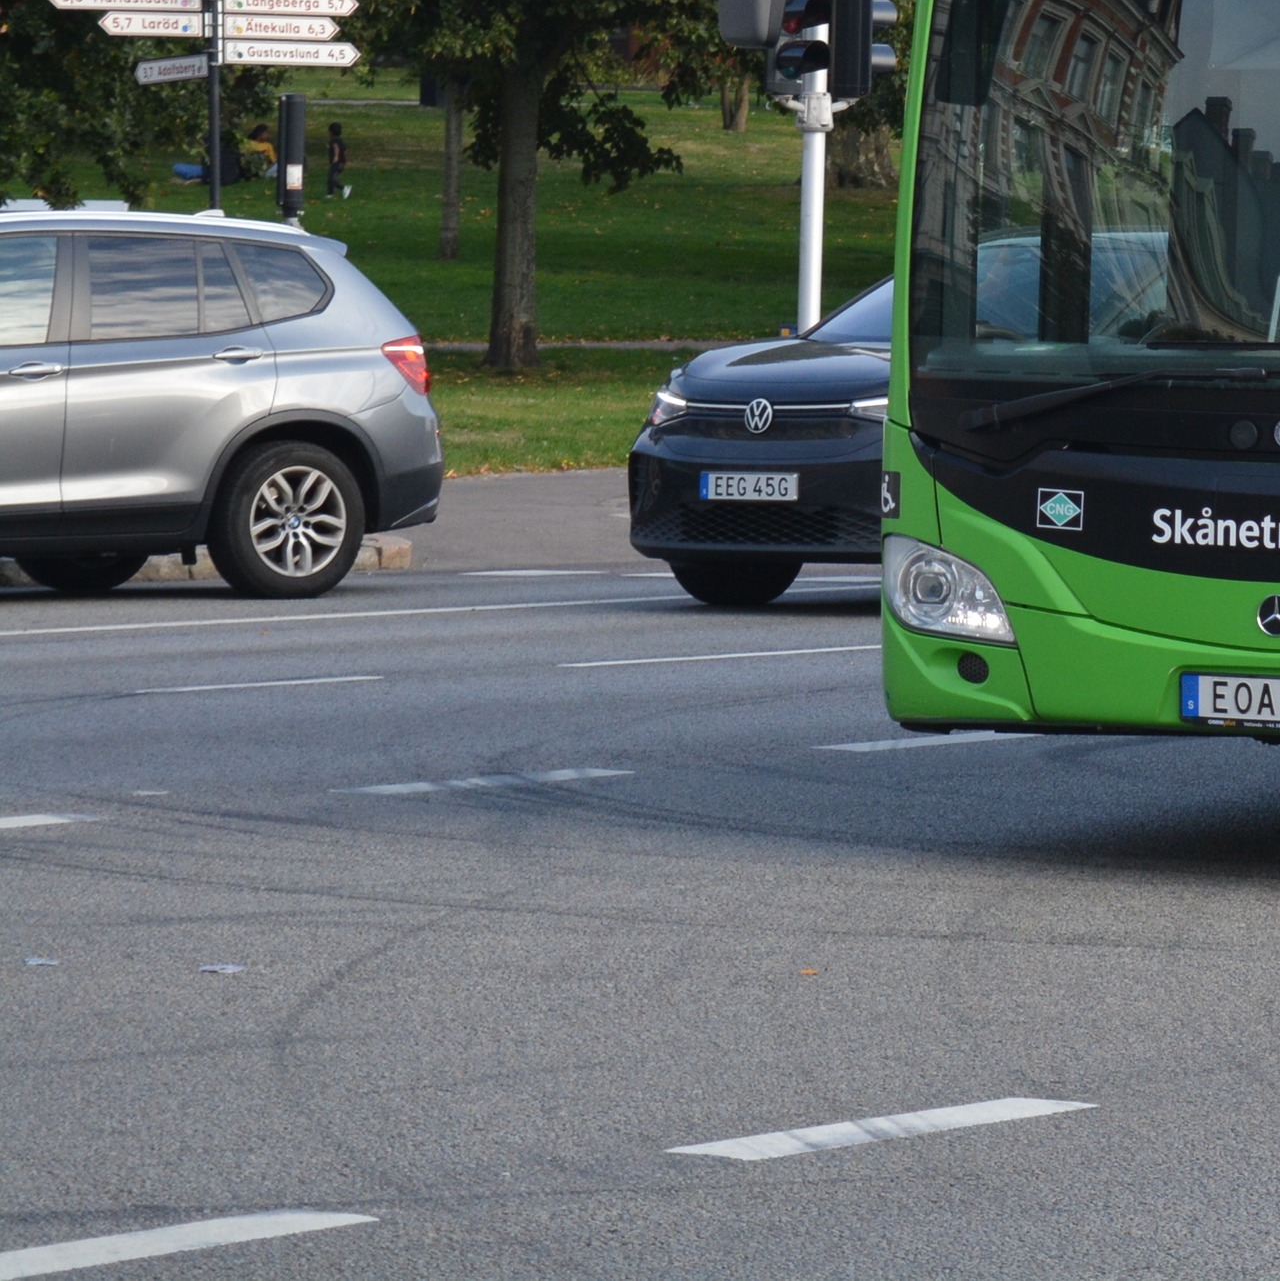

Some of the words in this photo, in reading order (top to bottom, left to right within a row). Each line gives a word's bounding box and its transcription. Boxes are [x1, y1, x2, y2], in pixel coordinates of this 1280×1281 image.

[327, 0, 345, 11] 5,7
[112, 18, 132, 31] 5,7
[142, 18, 179, 30] Laröd
[245, 18, 300, 34] Ättekulla
[307, 24, 326, 36] 6,3
[247, 46, 320, 59] Gustavslund
[327, 50, 346, 61] 4,5
[715, 476, 747, 496] EEG
[753, 476, 788, 497] 45G
[1046, 502, 1074, 516] CNG
[1187, 700, 1194, 709] S
[1213, 681, 1275, 715] EOA
